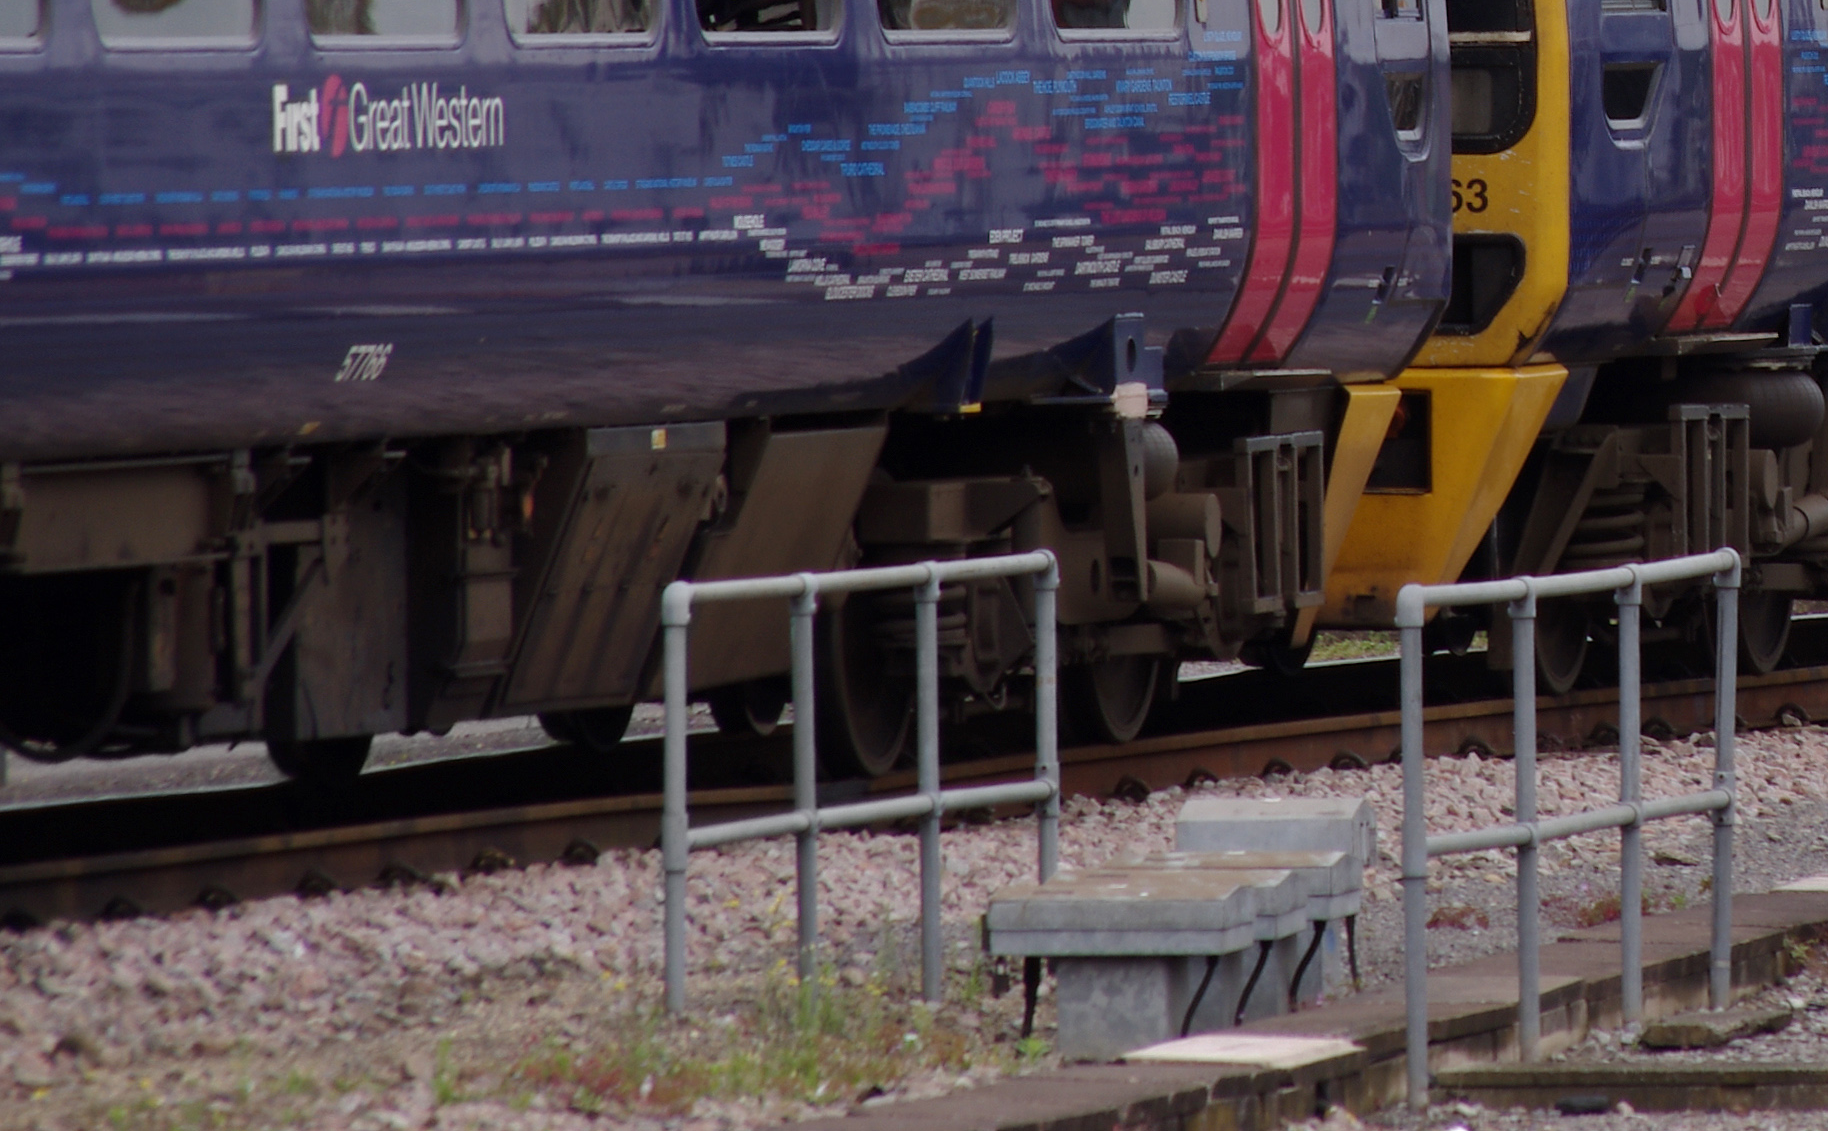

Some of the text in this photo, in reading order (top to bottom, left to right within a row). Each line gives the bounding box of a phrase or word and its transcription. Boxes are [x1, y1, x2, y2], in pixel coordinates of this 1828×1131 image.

[272, 81, 505, 153] First Great Western
